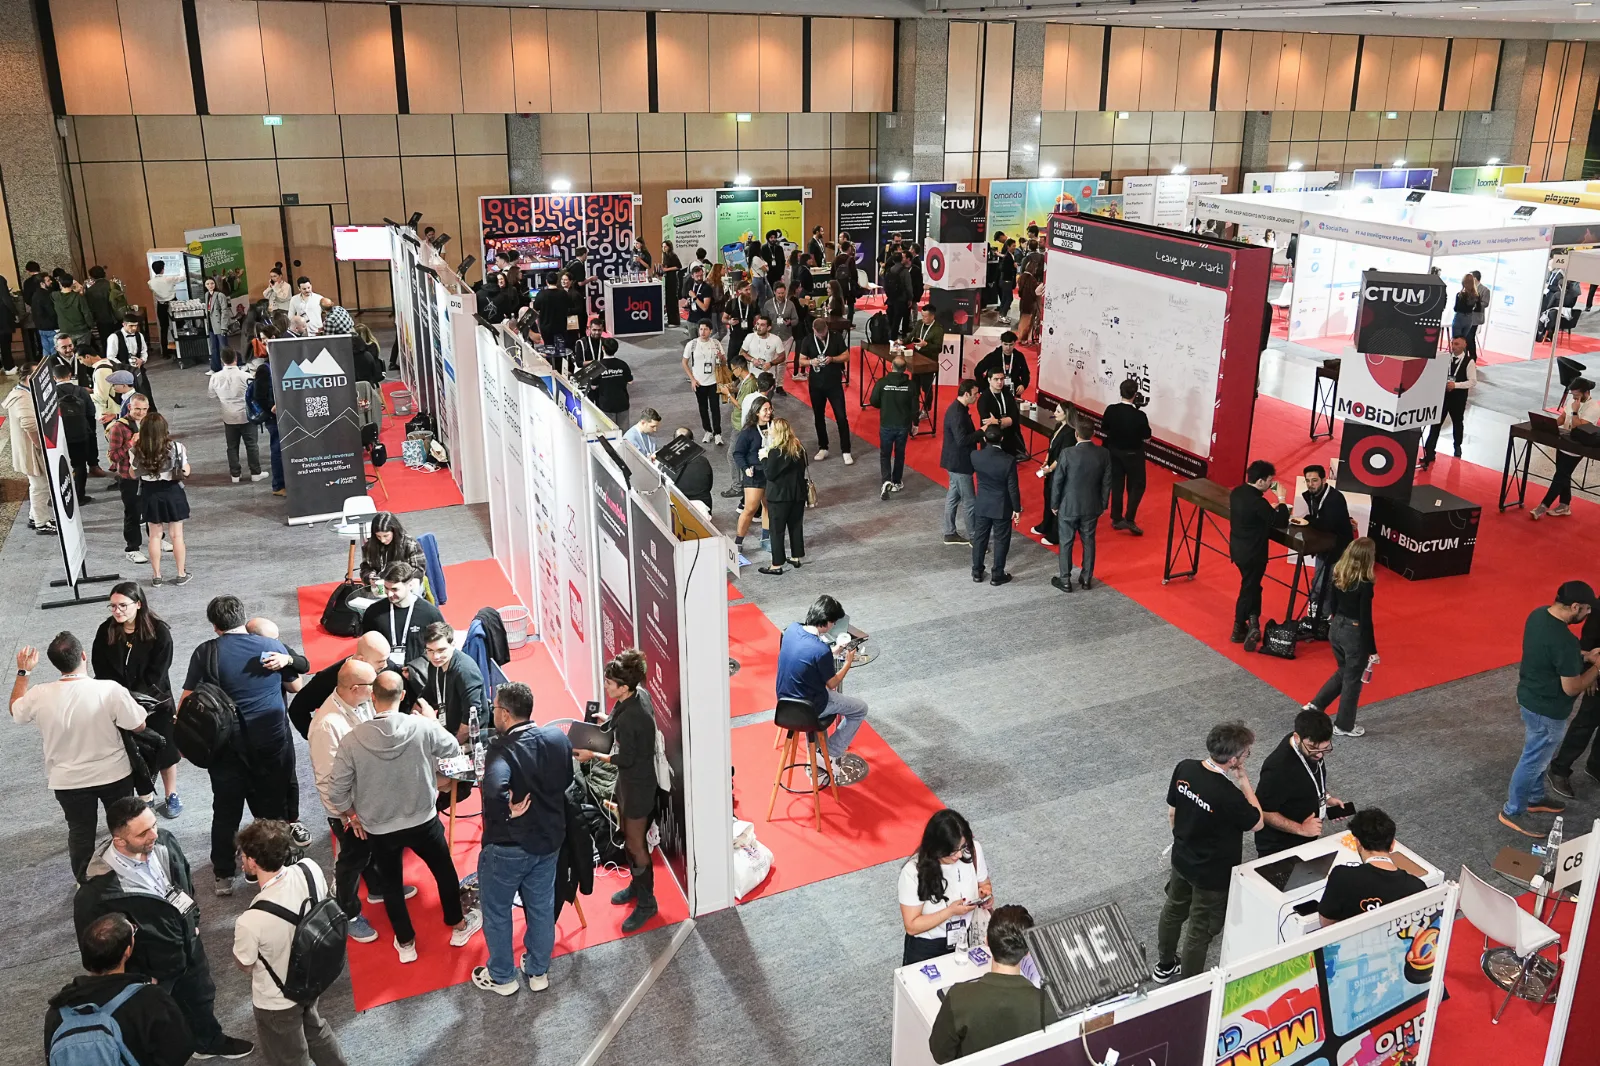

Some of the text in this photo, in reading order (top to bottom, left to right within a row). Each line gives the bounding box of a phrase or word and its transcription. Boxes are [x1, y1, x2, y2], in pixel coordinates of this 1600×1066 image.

[680, 196, 703, 204] aarki
[1543, 194, 1581, 206] playgap
[1061, 239, 1074, 249] 2025
[1155, 251, 1224, 275] Leave your Mark!
[1365, 286, 1425, 304] CTUM
[450, 300, 462, 309] D10
[281, 375, 348, 391] PEAKBID
[308, 455, 323, 463] peak
[1177, 783, 1214, 813] clerion.
[1563, 851, 1583, 872] C8
[1060, 924, 1119, 972] HE
